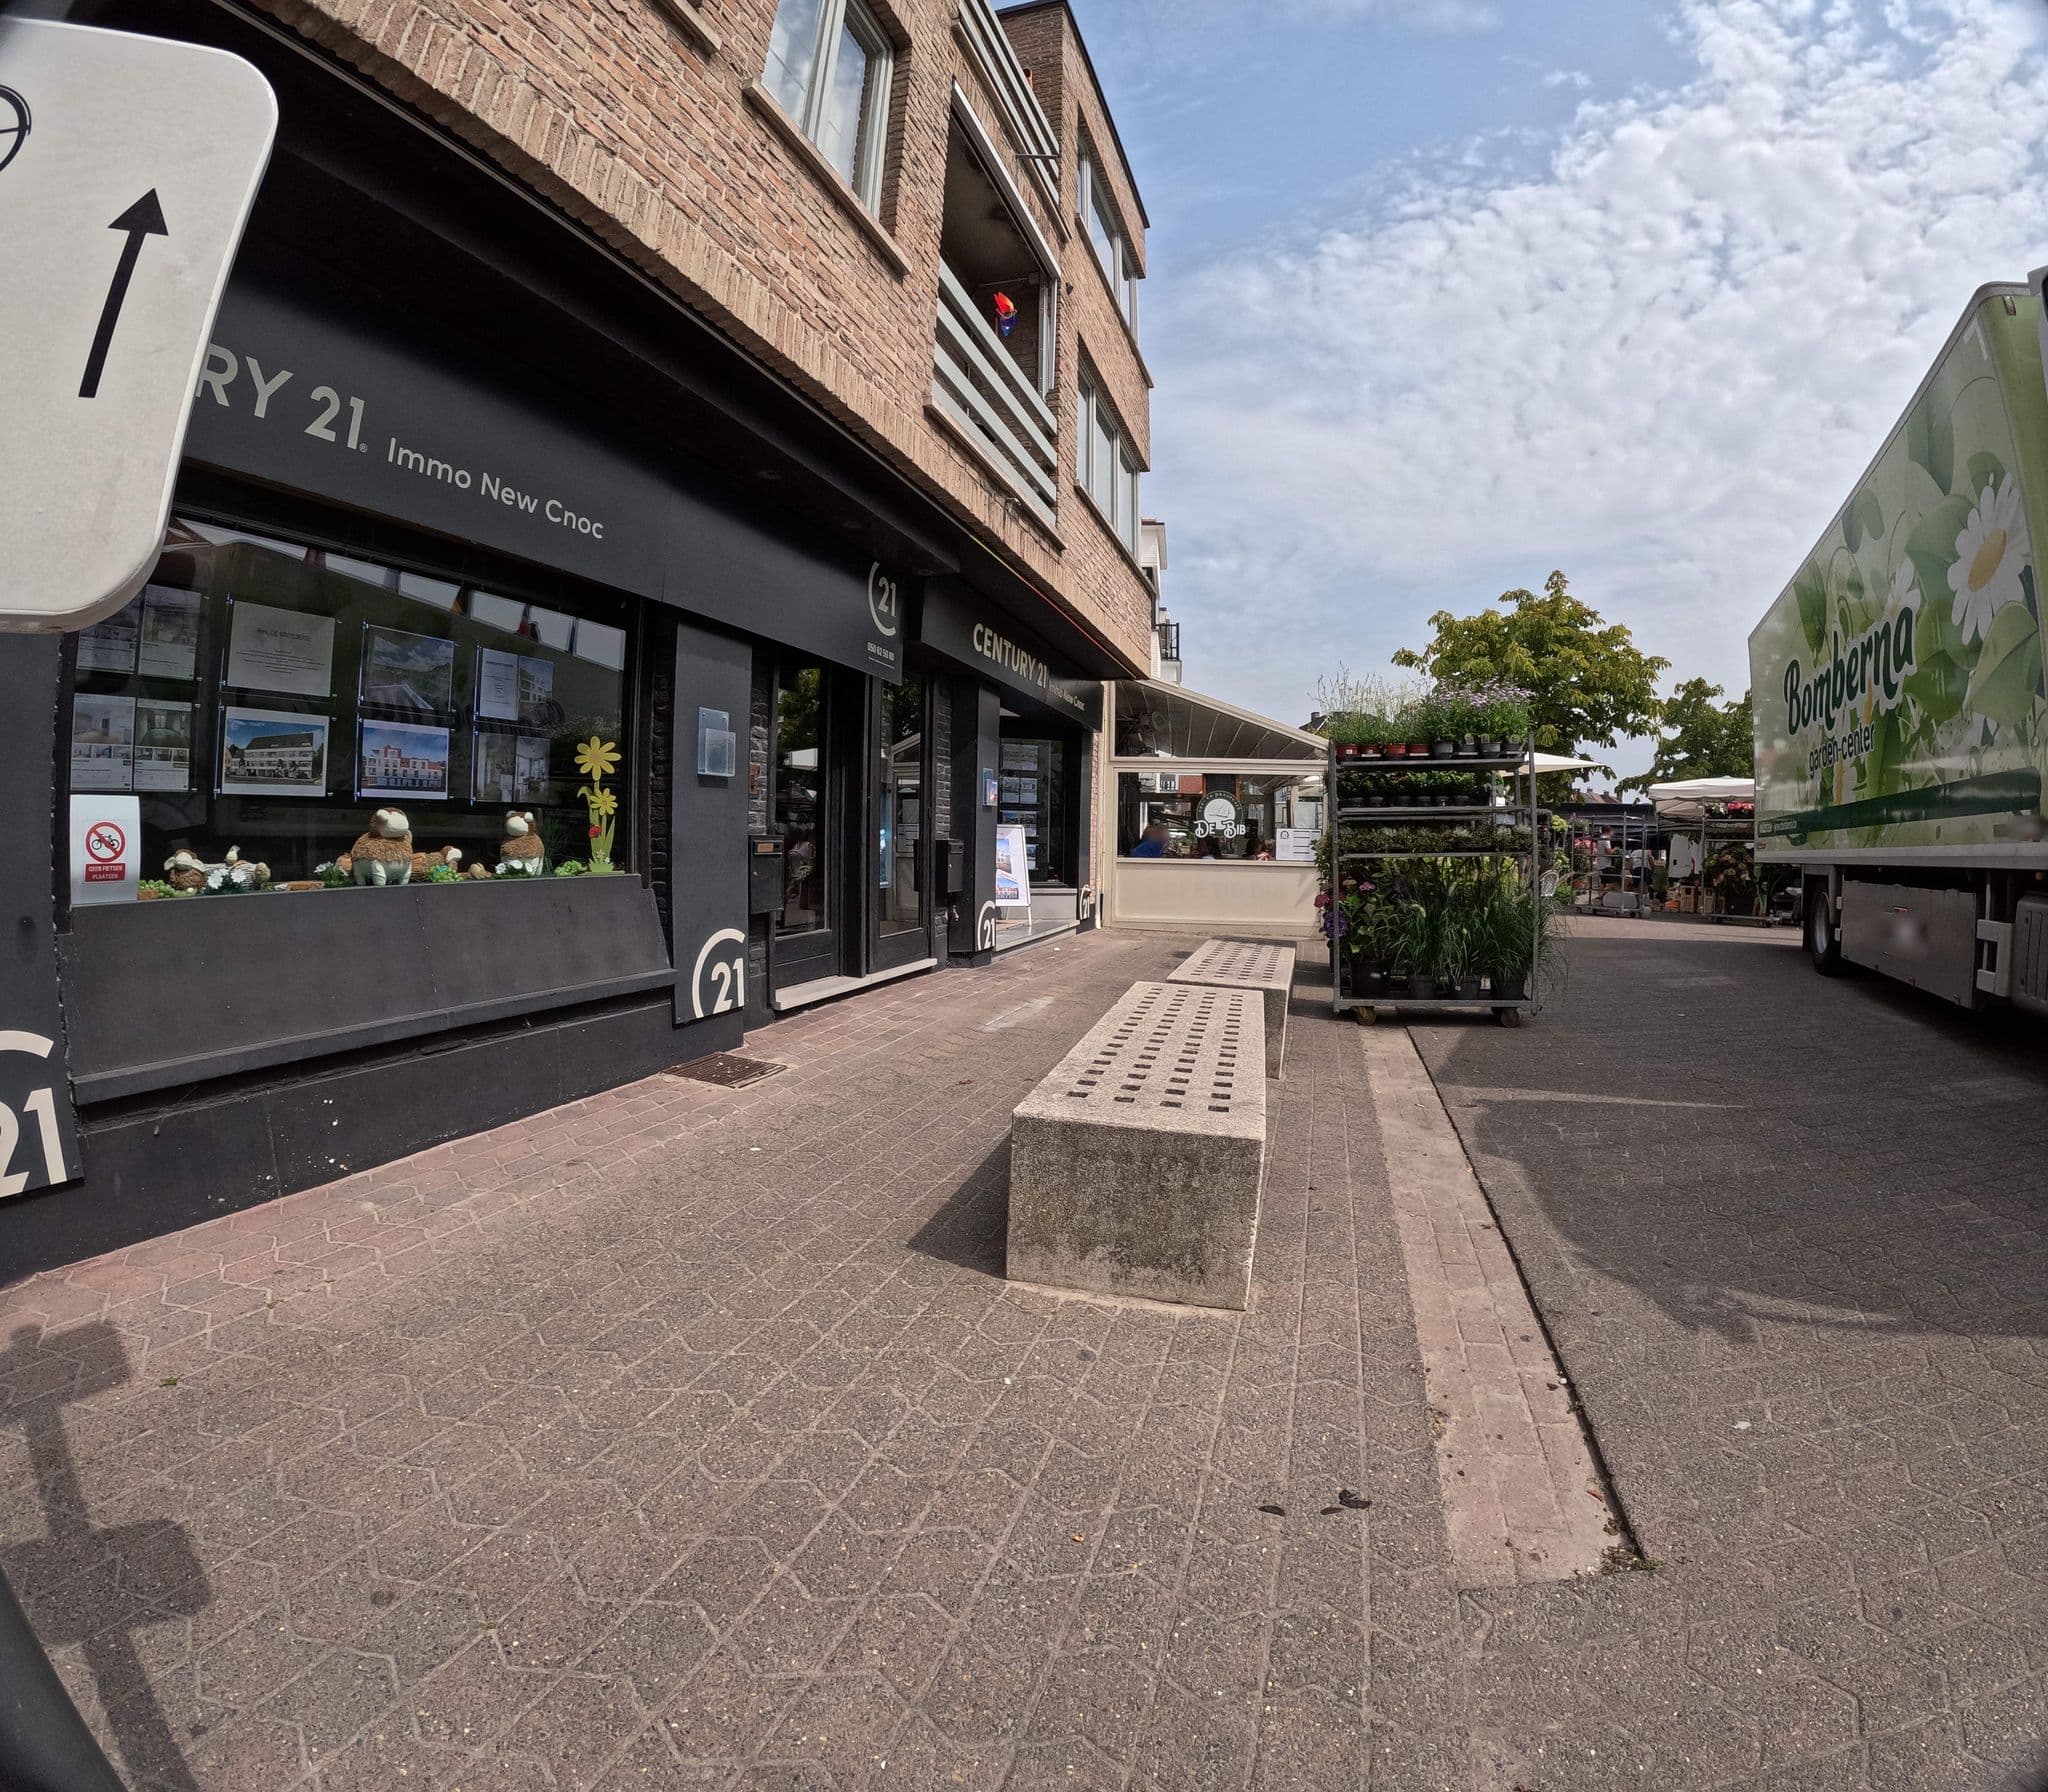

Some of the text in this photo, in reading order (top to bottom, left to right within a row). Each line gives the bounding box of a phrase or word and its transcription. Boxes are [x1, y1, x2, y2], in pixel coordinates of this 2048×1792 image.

[387, 437, 472, 489] Immo
[480, 472, 539, 514] New
[545, 499, 604, 540] Cnoc
[973, 623, 1036, 680] CENTURY
[1037, 662, 1048, 689] 21
[1784, 606, 1914, 736] Bomberna
[1809, 722, 1875, 780] garden-center
